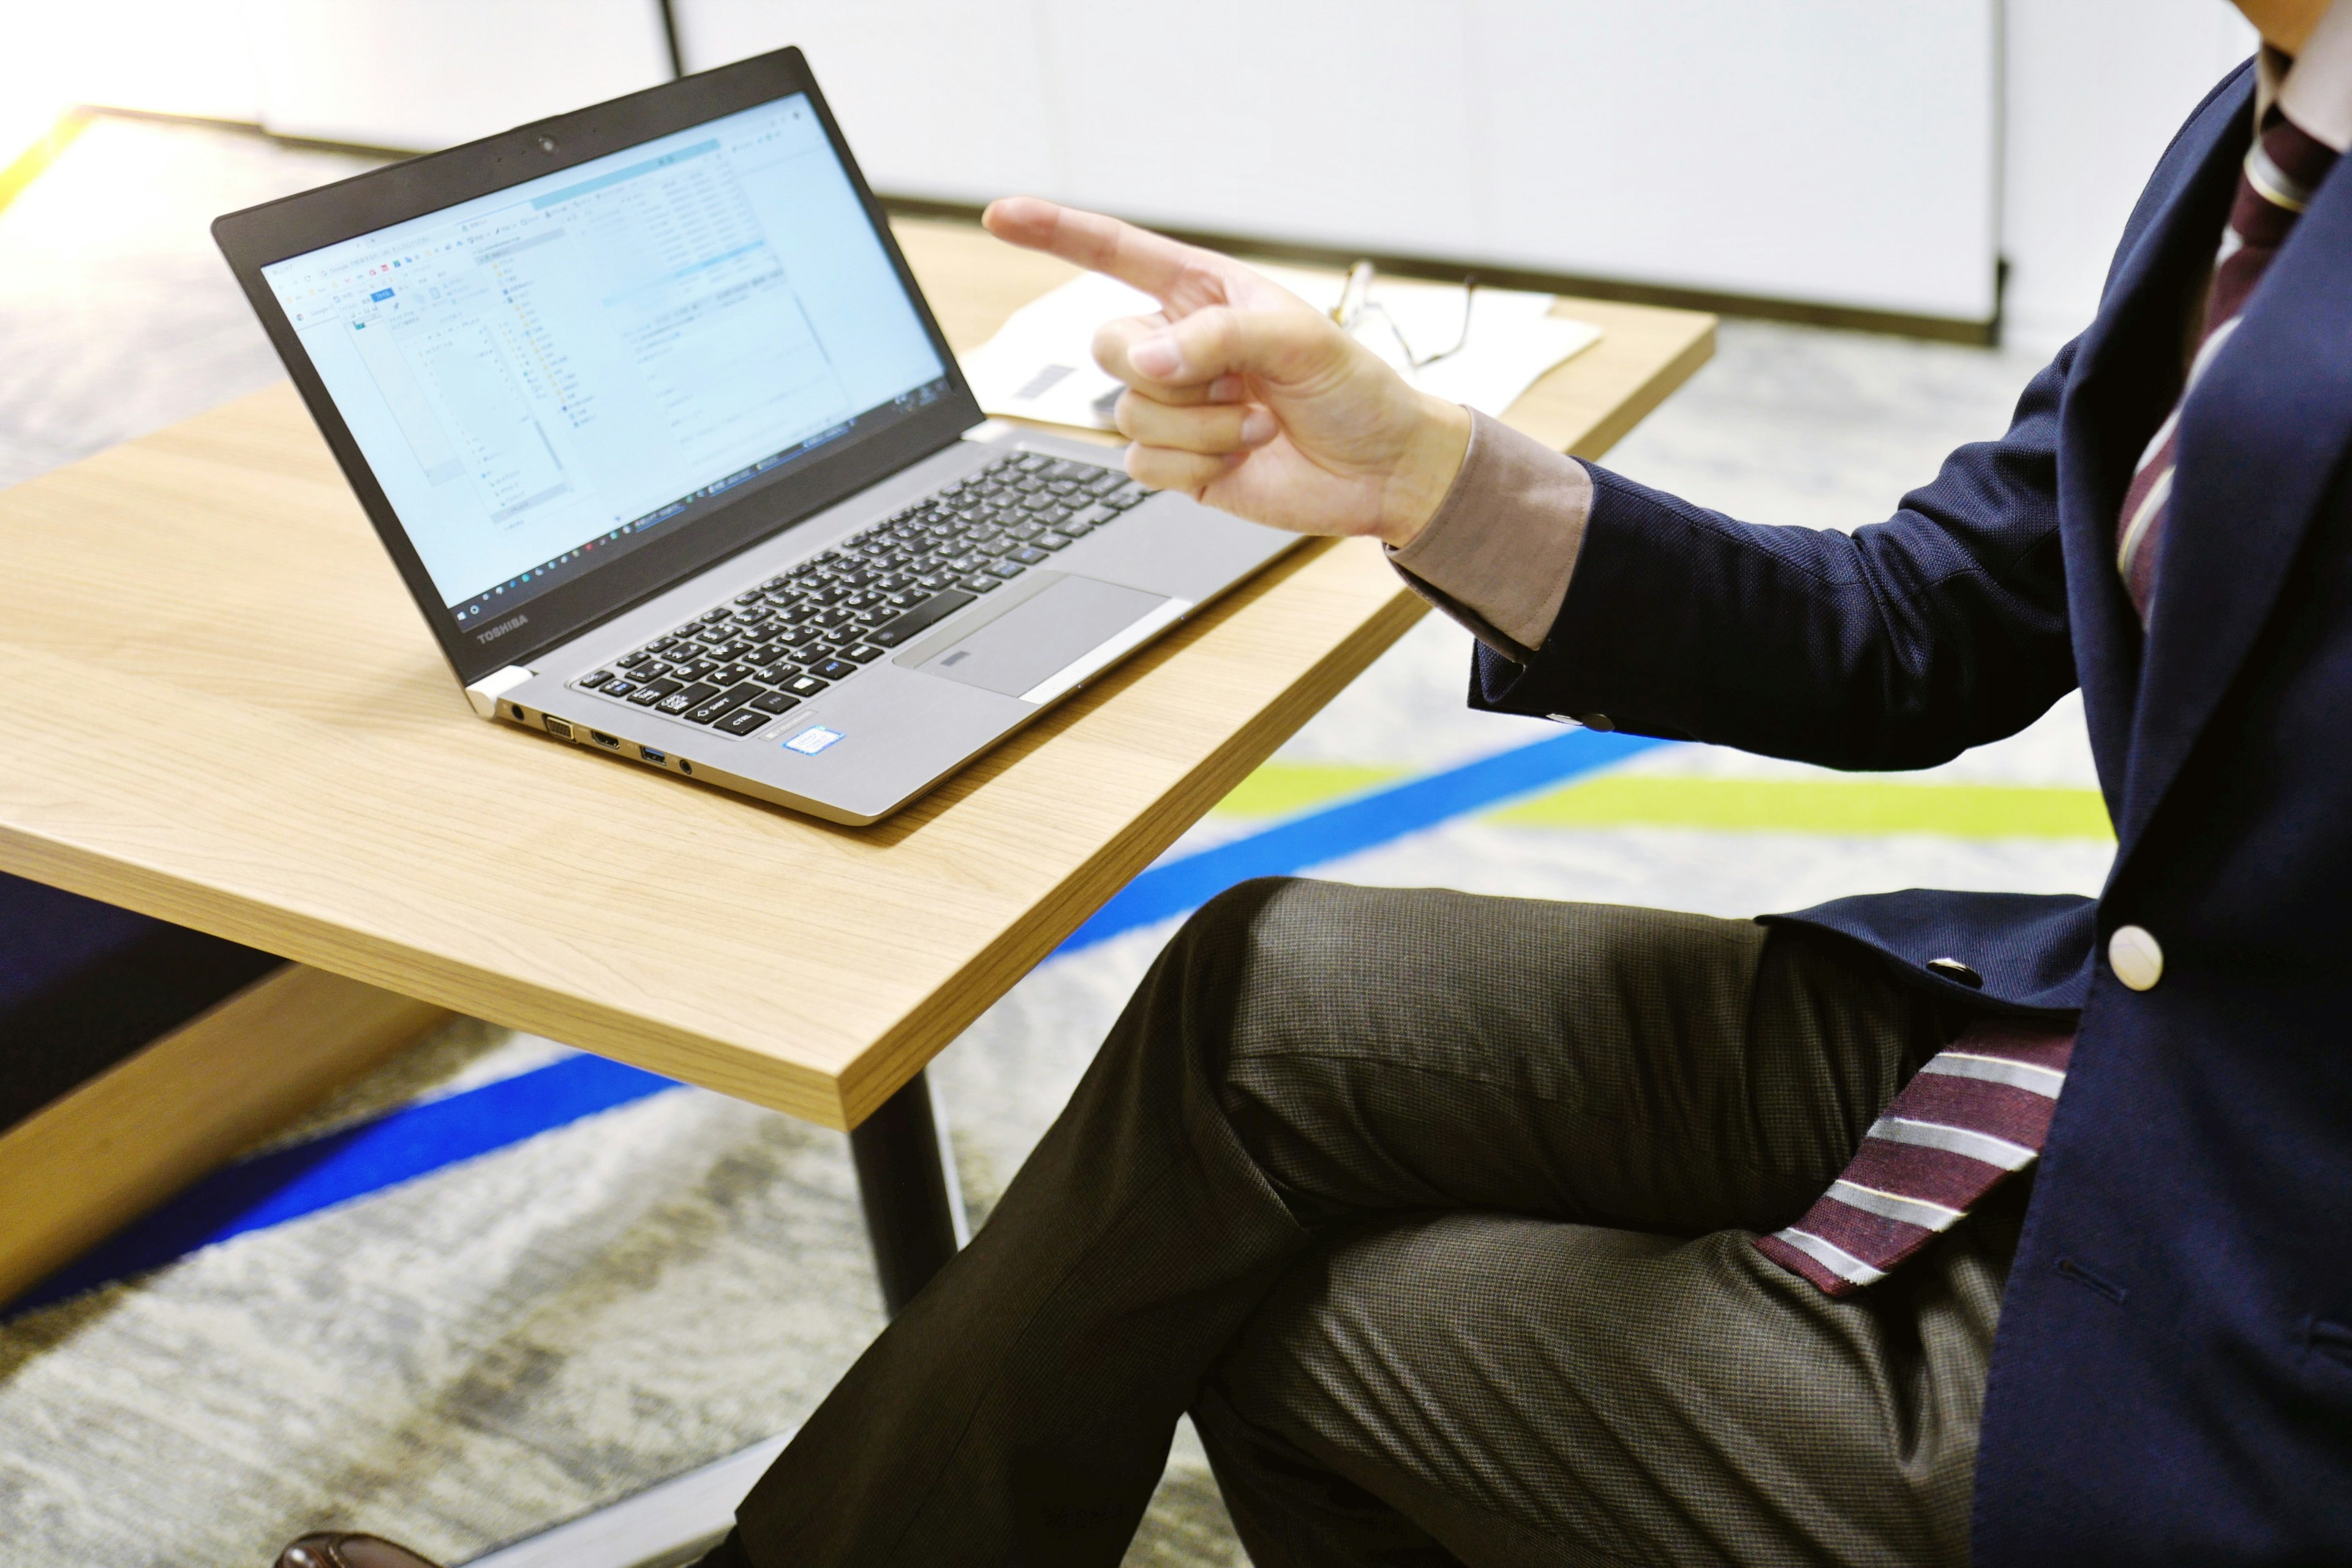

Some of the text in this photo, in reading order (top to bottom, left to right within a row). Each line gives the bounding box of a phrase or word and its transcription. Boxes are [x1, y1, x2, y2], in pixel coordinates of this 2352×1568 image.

[477, 614, 528, 644] TOSHIBA
[711, 645, 729, 655] W
[793, 650, 807, 659] X
[677, 666, 692, 675] Q
[758, 669, 773, 678] Z
[714, 671, 728, 680] A
[709, 697, 729, 711] SHIFT
[732, 714, 753, 726] CTRL
